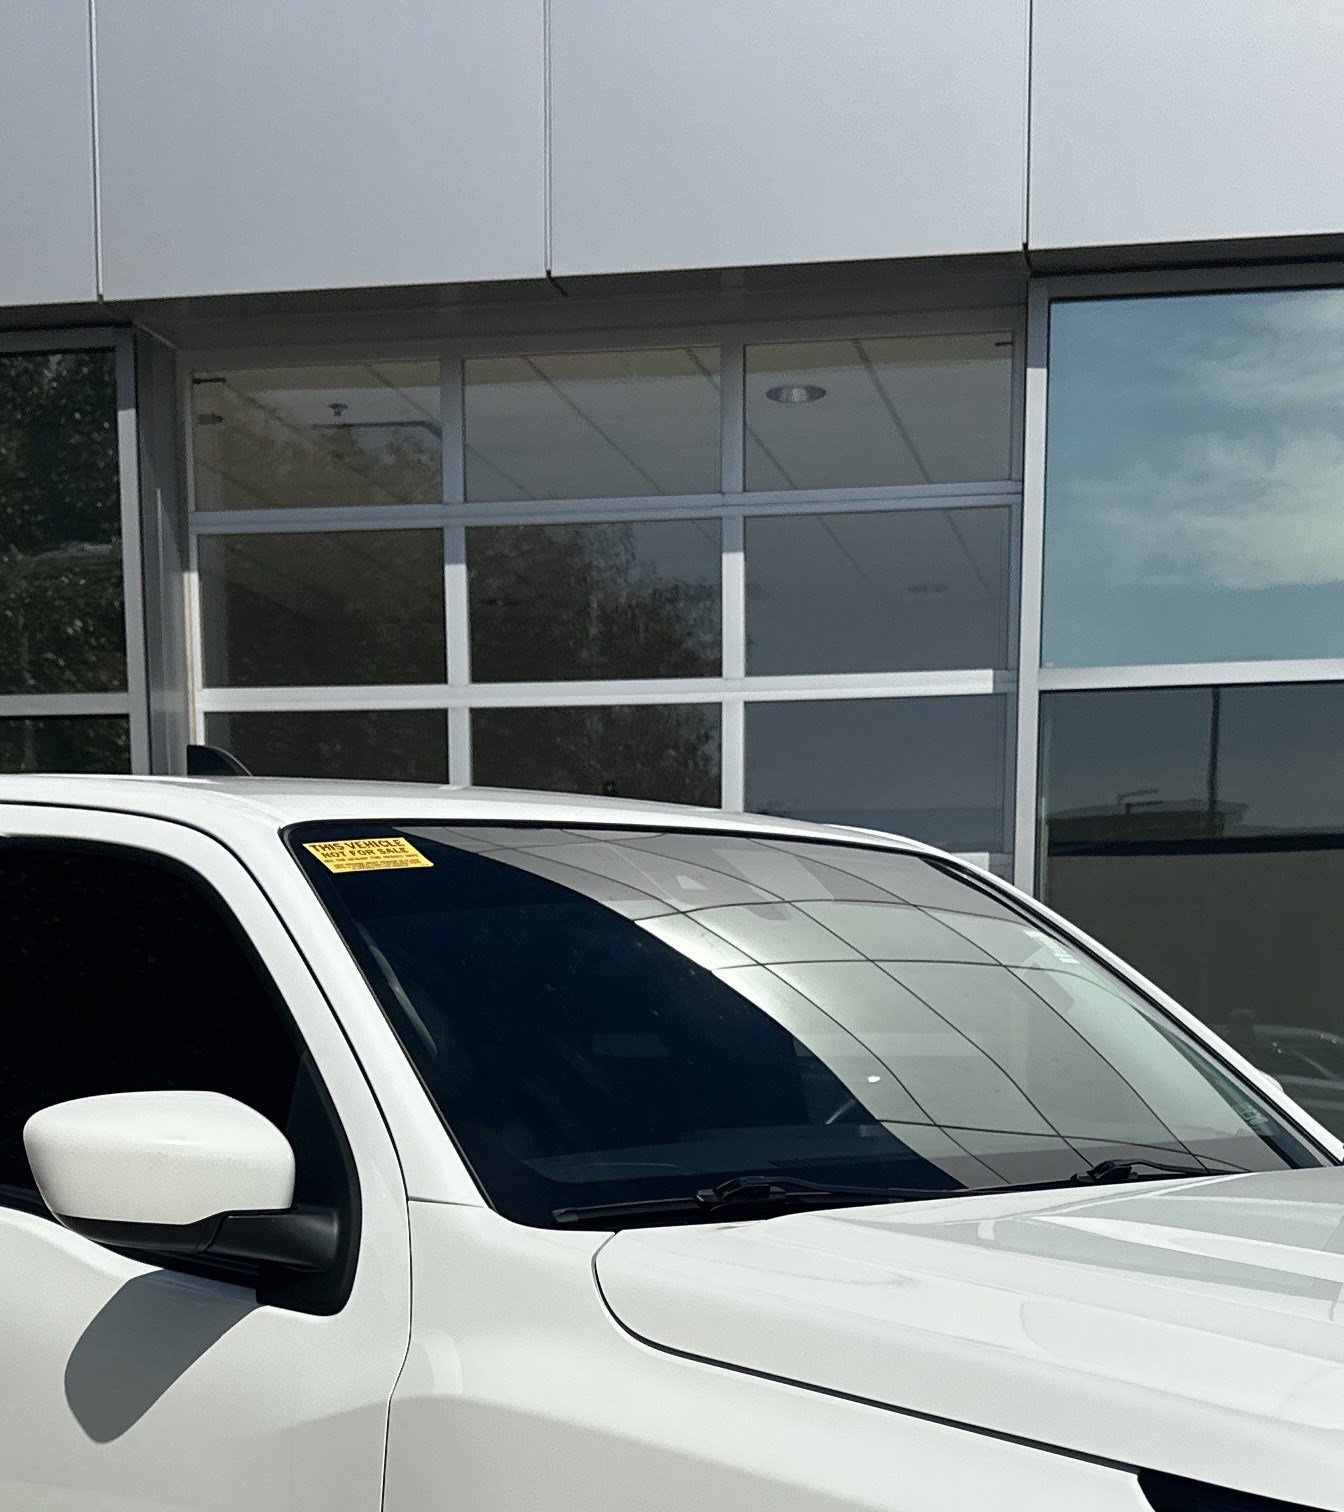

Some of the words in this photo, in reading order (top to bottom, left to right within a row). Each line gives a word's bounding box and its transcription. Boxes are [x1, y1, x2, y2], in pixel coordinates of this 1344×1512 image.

[309, 842, 344, 853] THIS
[345, 839, 406, 850] VEHICLE
[320, 851, 347, 859] NOT
[377, 847, 409, 855] SALE
